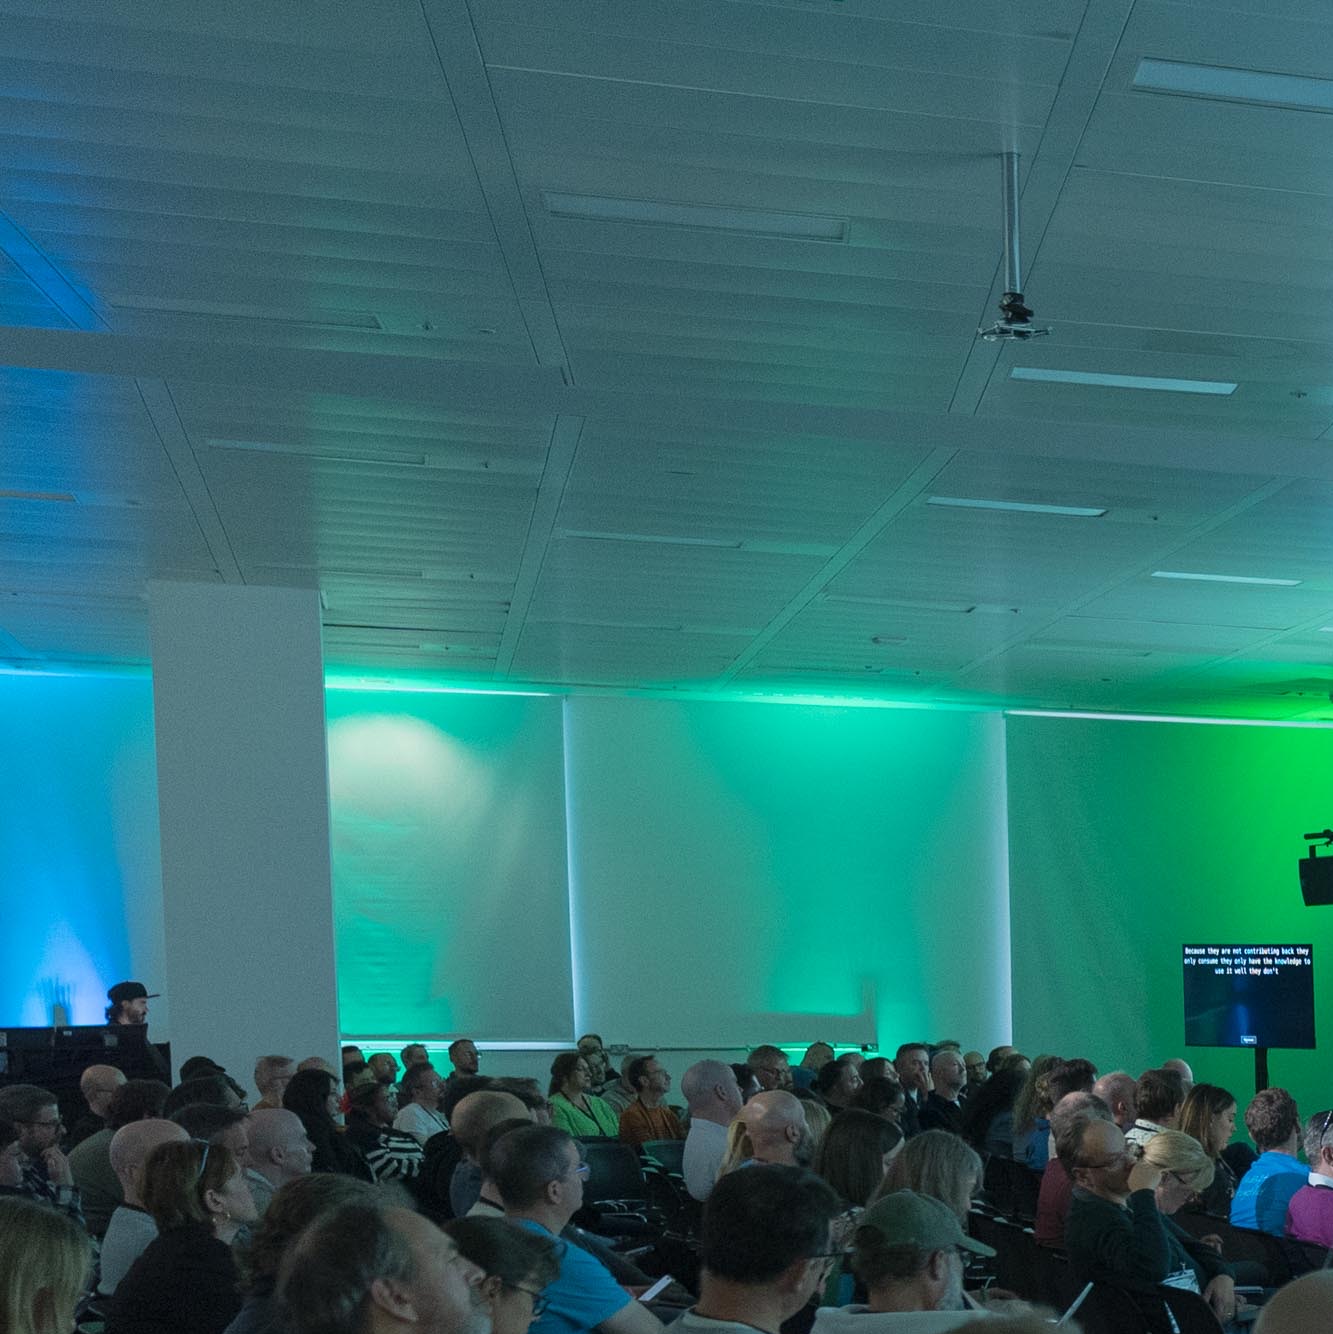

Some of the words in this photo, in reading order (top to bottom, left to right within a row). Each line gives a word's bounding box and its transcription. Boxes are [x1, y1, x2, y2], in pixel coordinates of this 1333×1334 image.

[1185, 947, 1206, 955] Because
[1207, 947, 1220, 956] they
[1232, 947, 1242, 955] not
[1243, 947, 1280, 956] contributing
[1281, 947, 1294, 955] back
[1296, 947, 1309, 956] they
[1184, 957, 1196, 966] only
[1220, 957, 1233, 966] they
[1234, 957, 1247, 966] only
[1248, 957, 1261, 965] have
[1263, 957, 1273, 965] the
[1274, 957, 1302, 966] knowledge
[1226, 967, 1233, 975] it
[1234, 967, 1247, 975] well
[1249, 967, 1261, 976] they
[1263, 967, 1279, 975] don't
